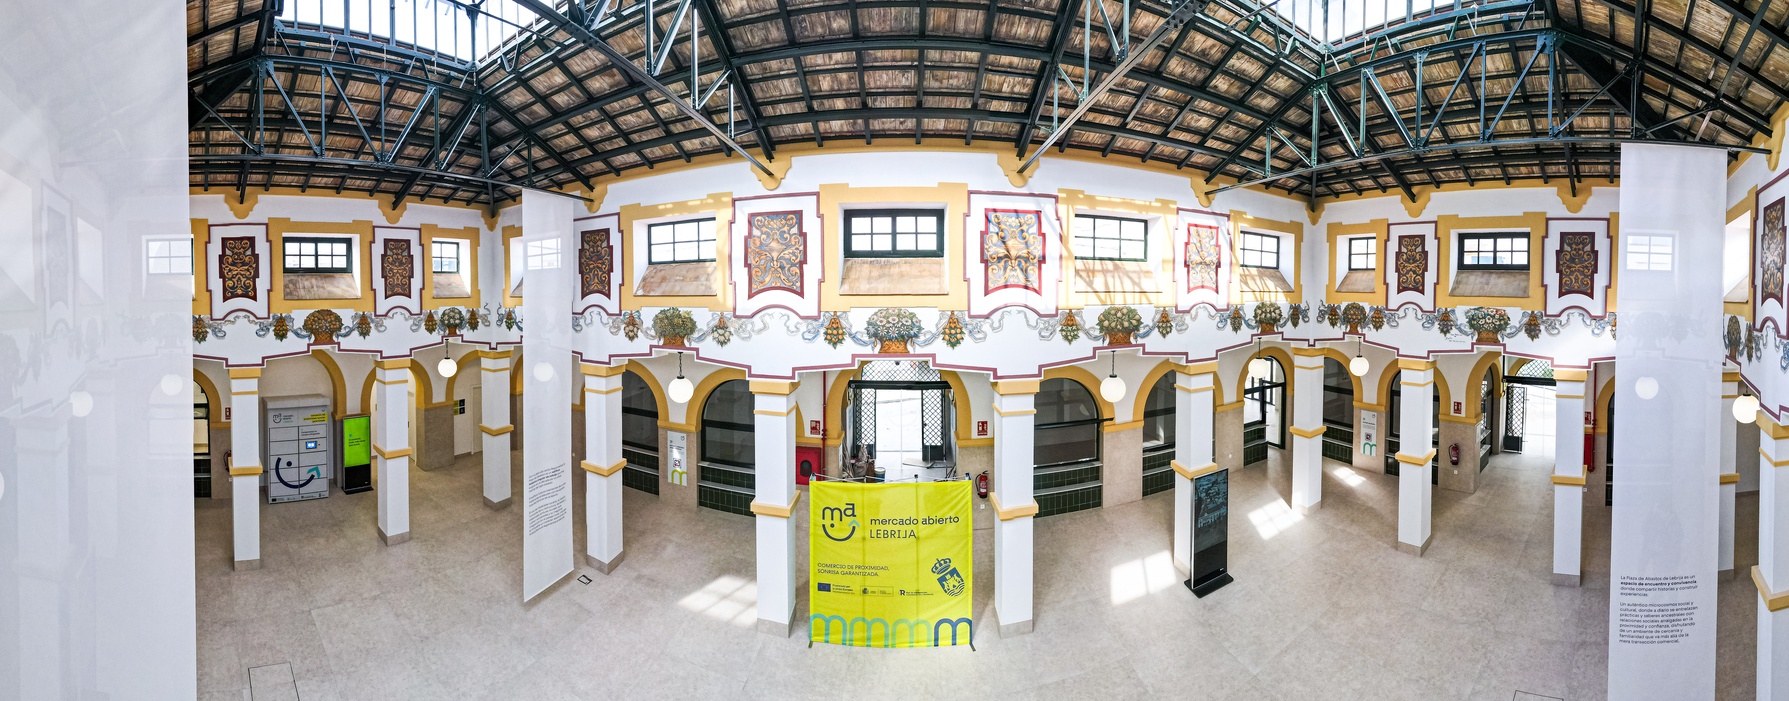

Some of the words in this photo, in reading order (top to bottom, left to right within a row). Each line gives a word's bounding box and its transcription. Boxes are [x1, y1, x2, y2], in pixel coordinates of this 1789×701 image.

[822, 503, 856, 521] ma
[870, 516, 918, 525] mercado
[922, 515, 959, 525] abierto
[870, 530, 917, 538] LEBRIJA
